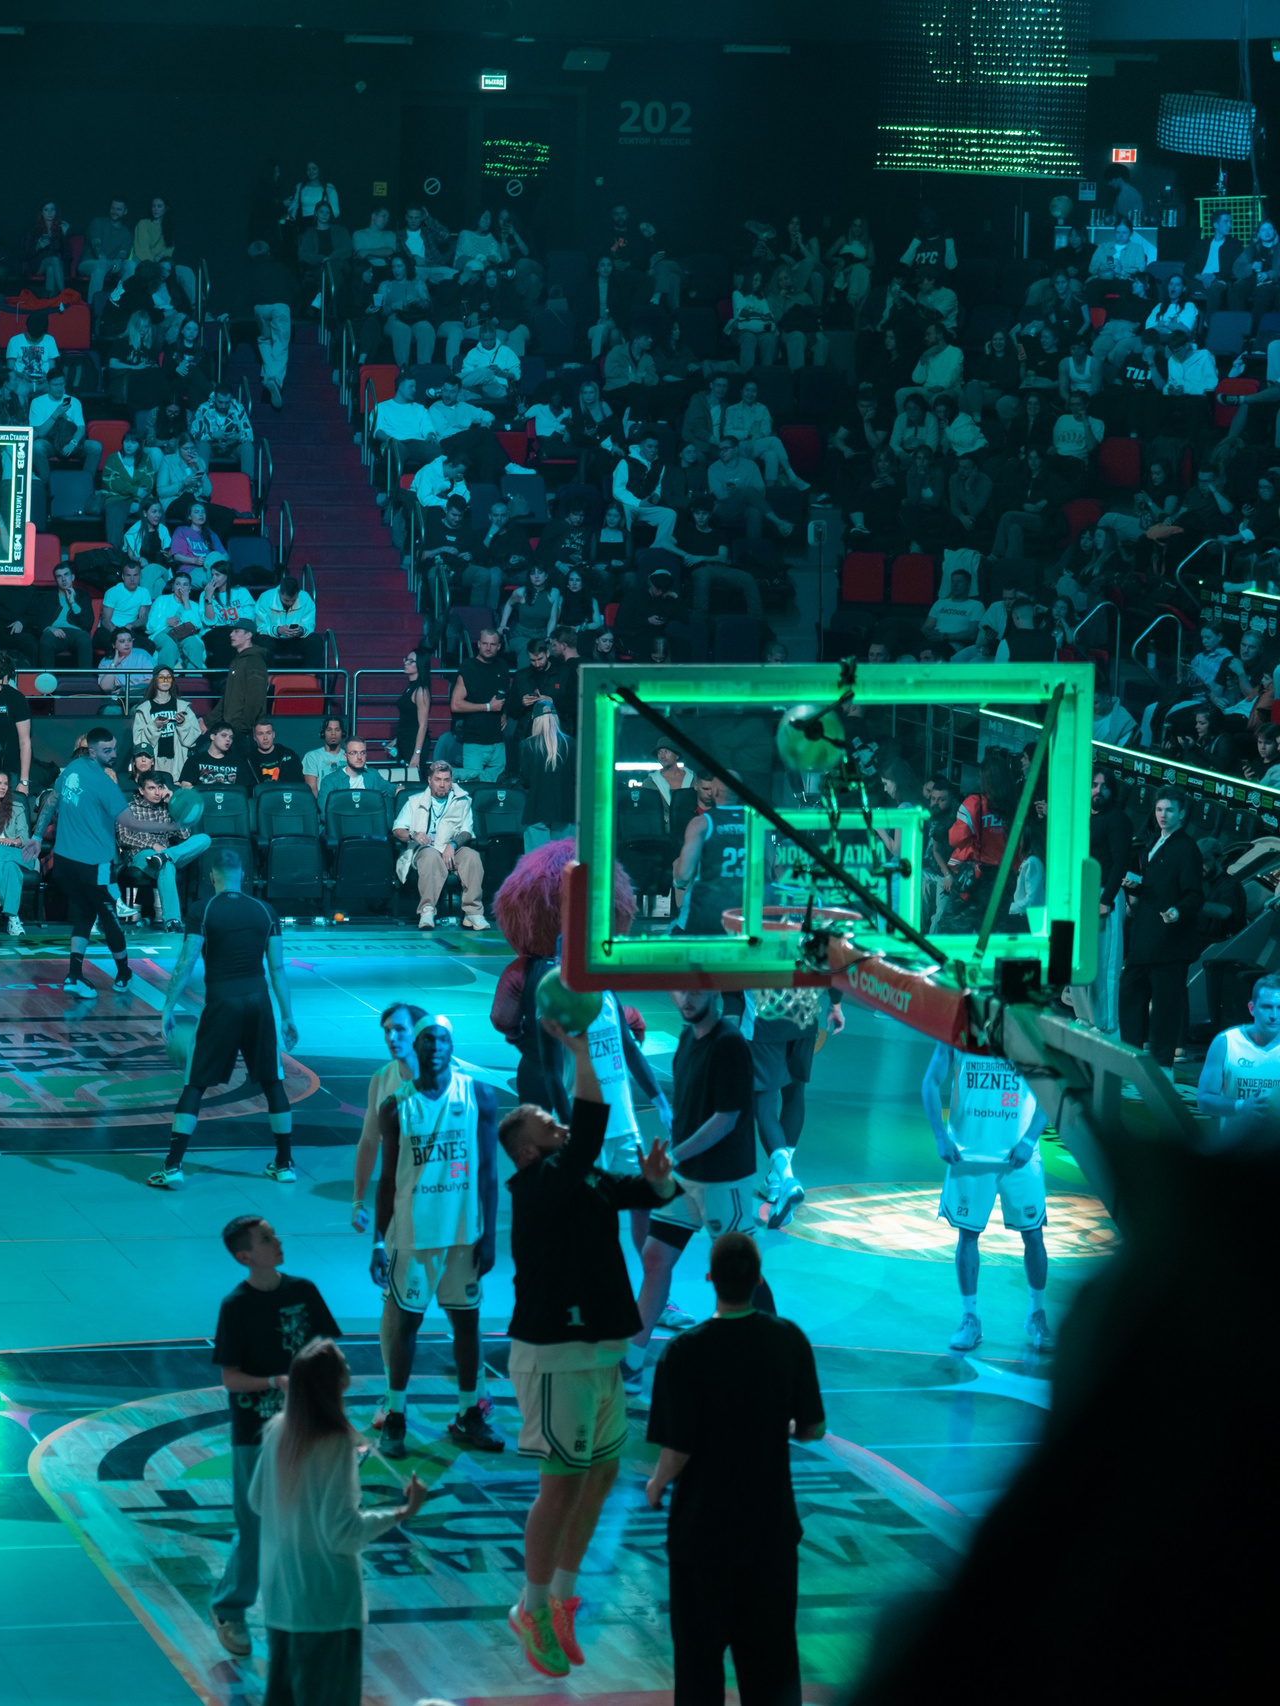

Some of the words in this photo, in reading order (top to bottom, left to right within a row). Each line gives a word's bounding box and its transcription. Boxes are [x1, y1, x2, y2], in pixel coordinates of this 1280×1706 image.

[619, 100, 693, 134] 202
[198, 763, 238, 774] IVERSON
[1133, 760, 1152, 775] MB
[1215, 782, 1234, 798] MB
[966, 1072, 1020, 1091] BIZNES
[1001, 1092, 1019, 1107] 23
[973, 1108, 1018, 1121] babulya
[412, 1140, 468, 1167] BIZNES
[450, 1161, 469, 1178] 24
[421, 1181, 470, 1194] babulya
[567, 1305, 585, 1326] 1
